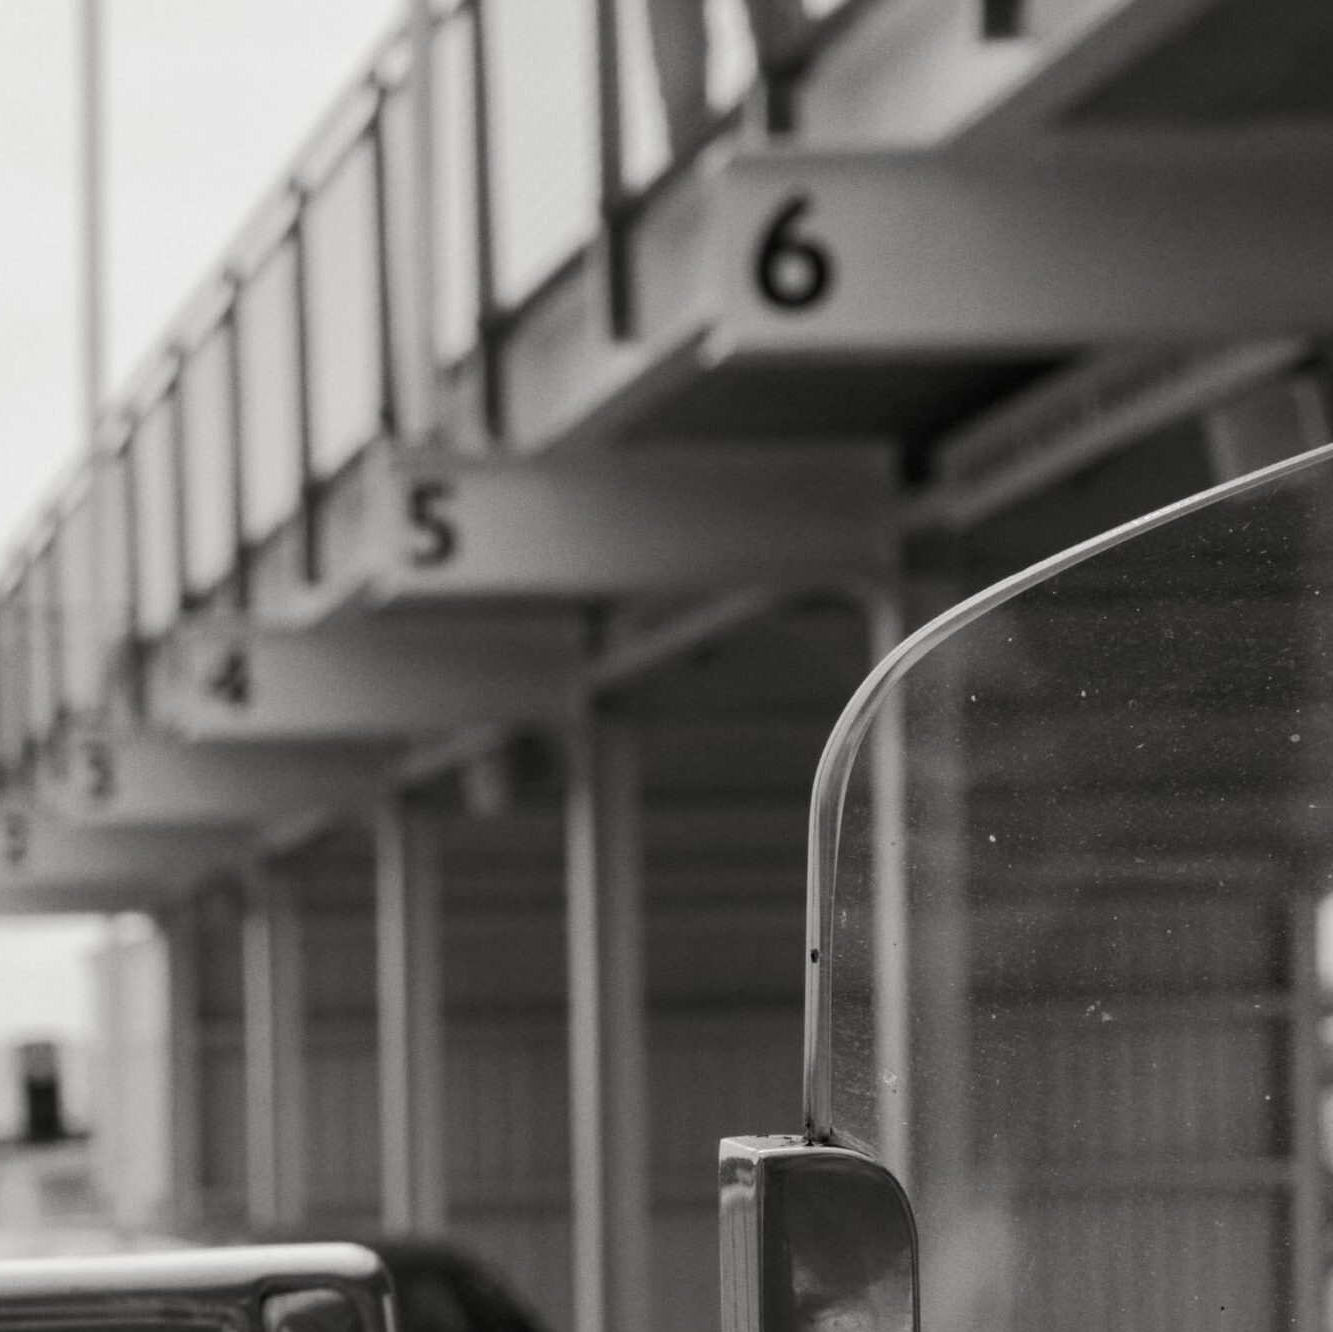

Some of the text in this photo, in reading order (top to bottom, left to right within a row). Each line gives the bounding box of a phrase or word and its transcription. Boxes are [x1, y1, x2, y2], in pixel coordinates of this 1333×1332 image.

[756, 192, 832, 313] 6
[407, 478, 457, 568] 5
[206, 650, 249, 705] 4
